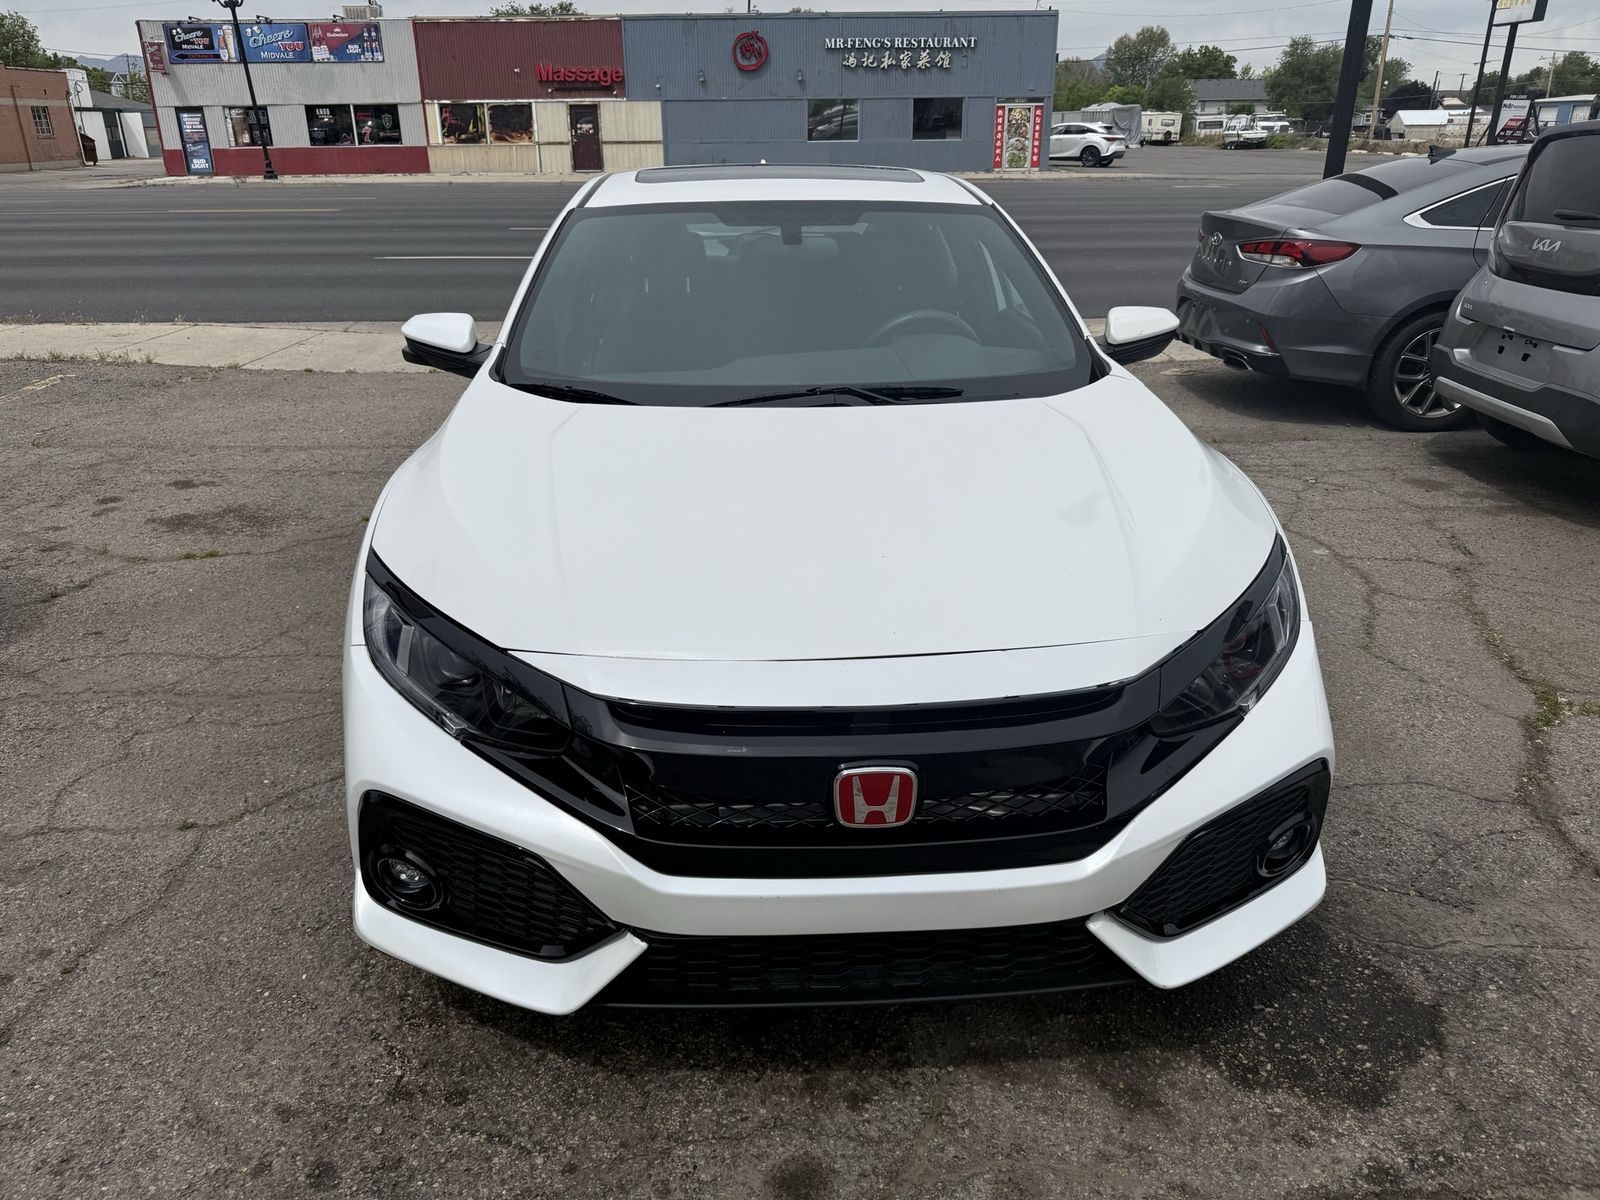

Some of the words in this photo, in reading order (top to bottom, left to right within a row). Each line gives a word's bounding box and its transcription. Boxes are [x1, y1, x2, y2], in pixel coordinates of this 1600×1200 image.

[175, 30, 203, 42] Cheers
[249, 29, 294, 48] Cheers
[278, 41, 305, 52] YOU
[894, 37, 978, 48] RESTAURANT
[260, 51, 295, 59] MIDVALE
[535, 63, 624, 86] Massage
